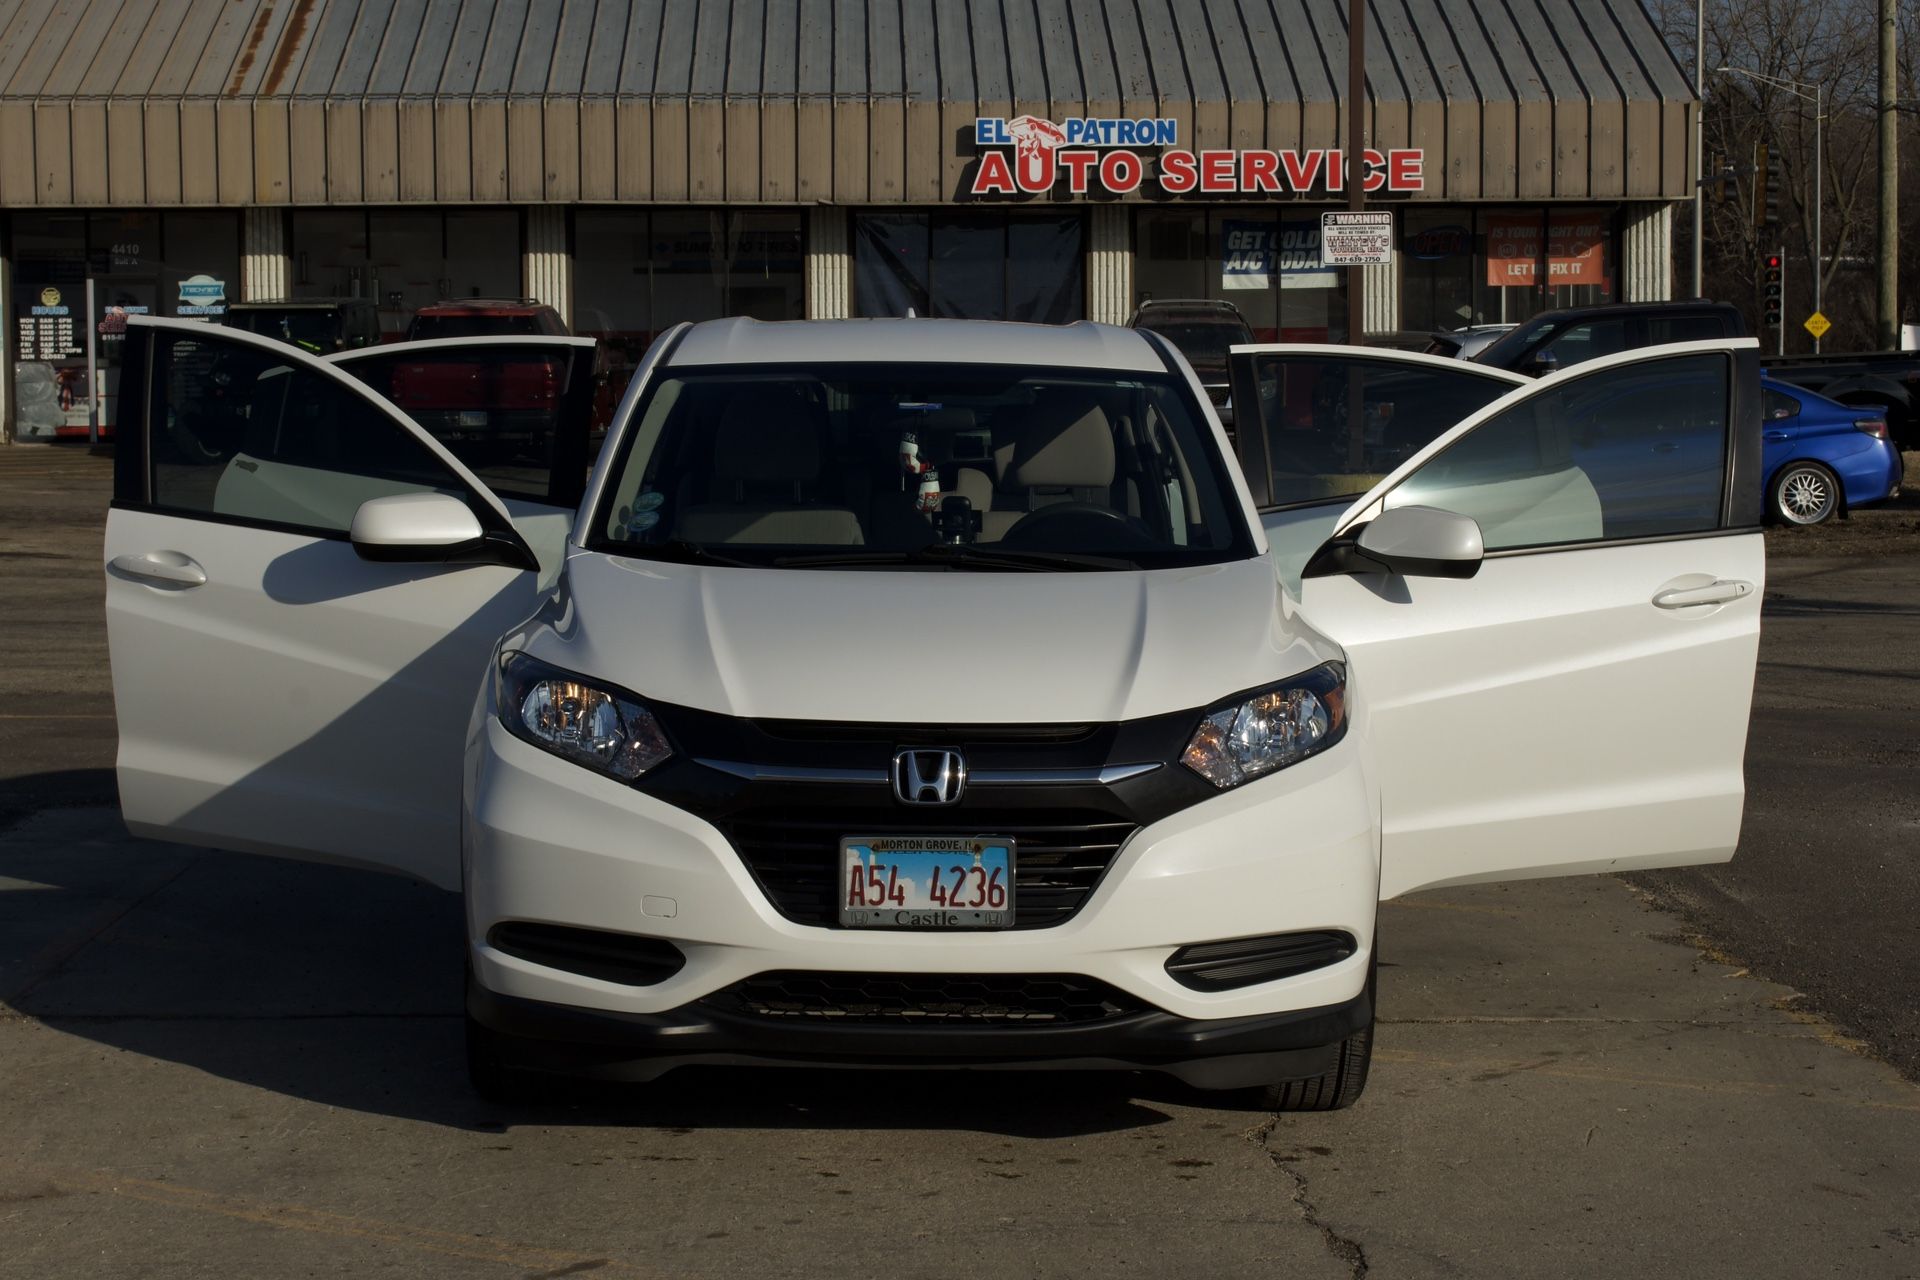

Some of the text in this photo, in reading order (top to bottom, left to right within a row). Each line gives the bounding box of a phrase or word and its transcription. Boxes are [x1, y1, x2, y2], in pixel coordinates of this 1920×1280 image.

[976, 117, 1177, 146] EL PATRON
[971, 148, 1425, 194] AUTO SERVICE
[1336, 214, 1390, 224] WARNING
[1227, 229, 1320, 249] GET COLD
[1326, 234, 1389, 247] WHITEY'S
[112, 244, 139, 255] 4410
[1226, 250, 1265, 270] A/C
[1507, 263, 1528, 275] LET
[1550, 263, 1568, 275] FIX
[1571, 262, 1582, 274] IT
[32, 306, 69, 315] HOURS
[881, 840, 923, 850] MORTON
[926, 840, 963, 850] GROVE,
[849, 864, 1005, 908] A54 4236
[895, 911, 959, 926] Castle
